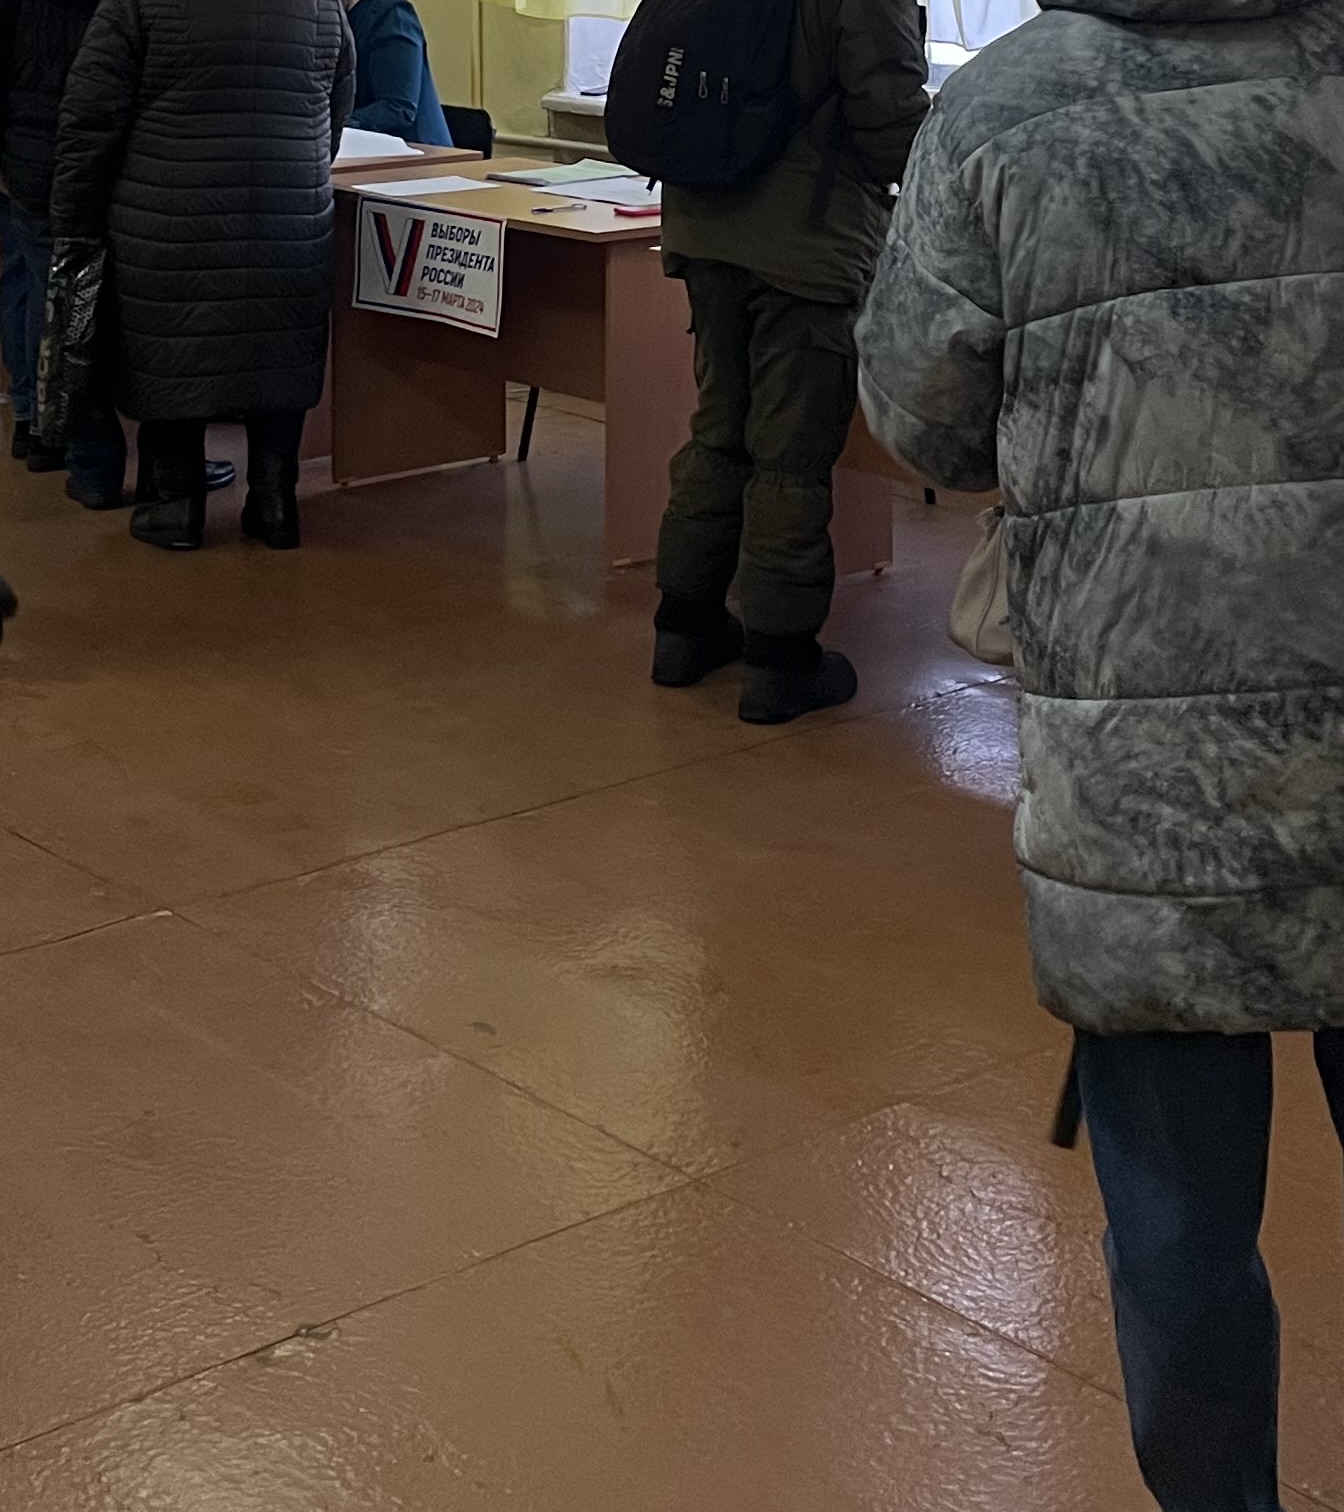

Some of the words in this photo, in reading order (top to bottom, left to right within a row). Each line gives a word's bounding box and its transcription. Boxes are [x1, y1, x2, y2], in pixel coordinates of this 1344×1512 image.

[431, 222, 481, 246] ВЫБОРЫ
[426, 244, 495, 272] ПРЕЗИДЕНТА
[420, 266, 465, 289] РОССИИ
